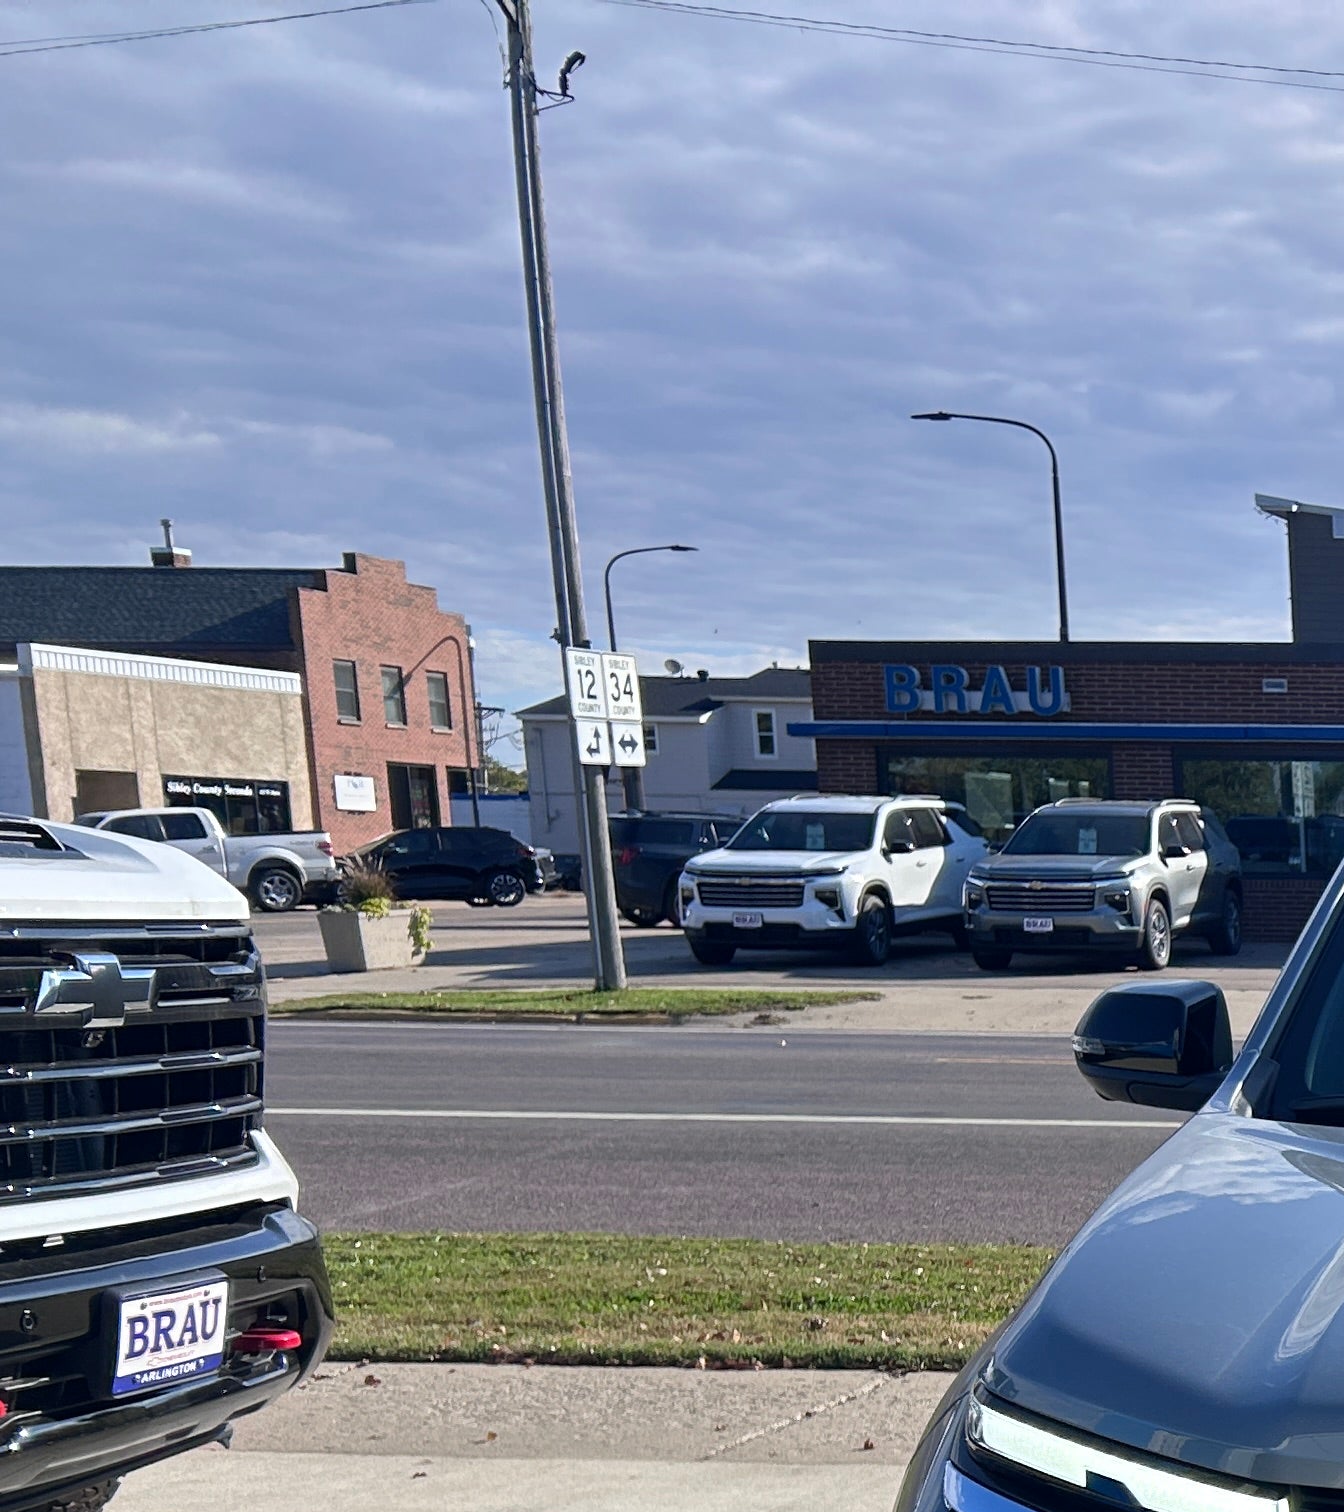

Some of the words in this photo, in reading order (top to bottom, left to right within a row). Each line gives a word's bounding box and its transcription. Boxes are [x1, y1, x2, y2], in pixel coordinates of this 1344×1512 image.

[574, 655, 595, 667] SIBLEY
[608, 659, 629, 671] SIBLEY
[577, 669, 597, 699] 12
[610, 672, 634, 703] 34
[884, 664, 1065, 716] BRAU
[578, 702, 601, 713] COUNTY
[613, 705, 635, 716] COUNTY
[124, 1296, 222, 1361] BRAU
[141, 1360, 197, 1383] ARLINGTON
